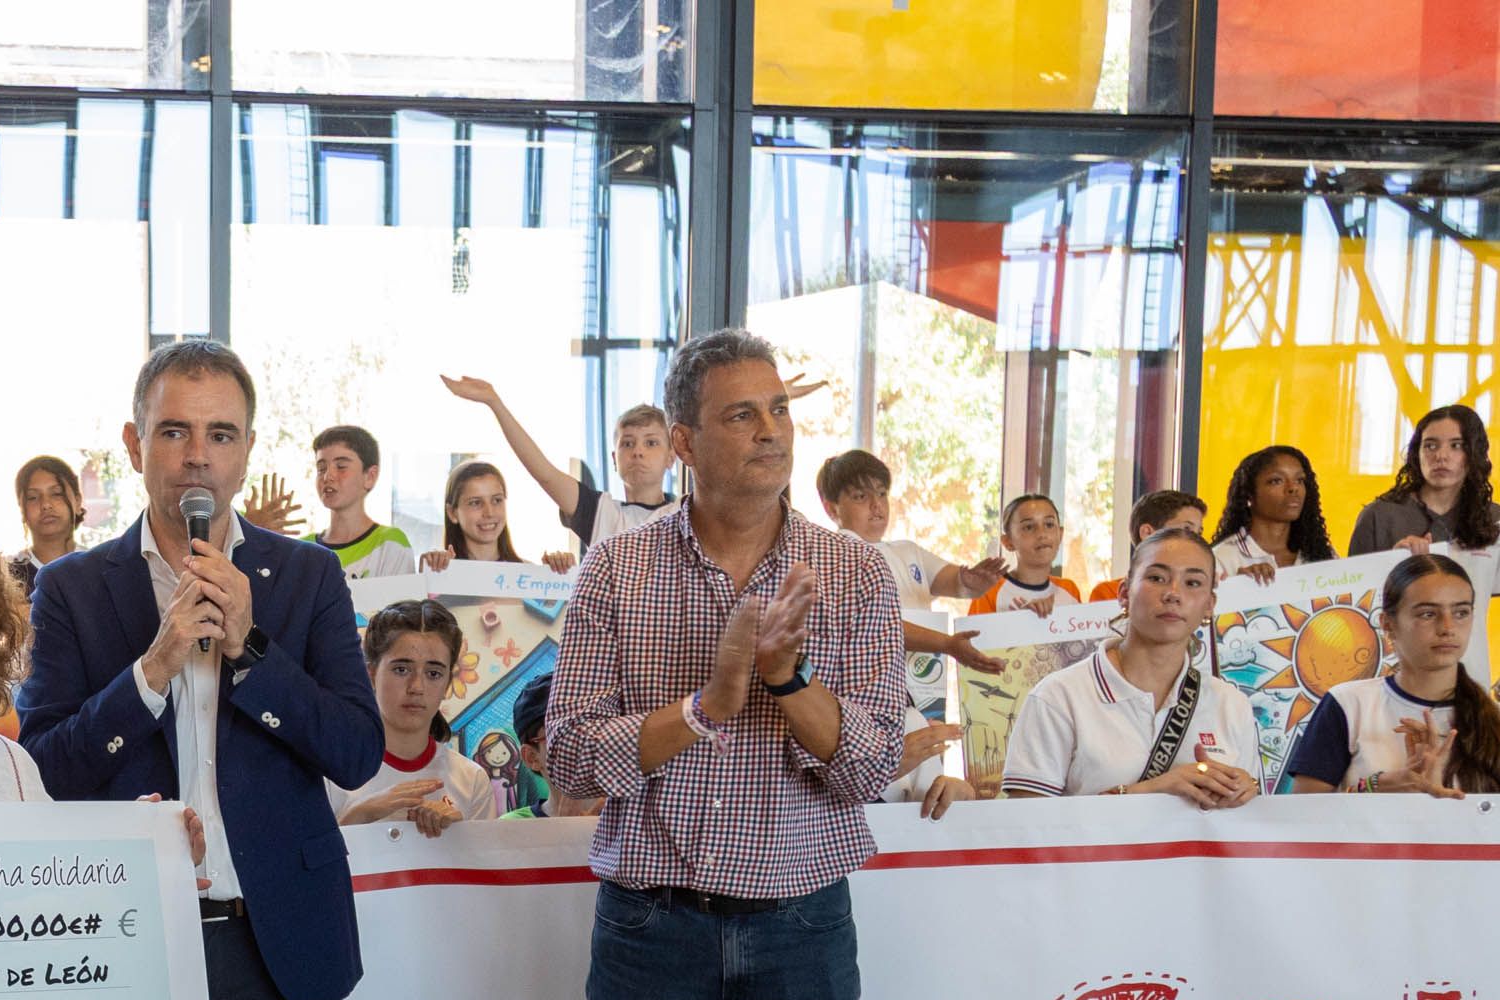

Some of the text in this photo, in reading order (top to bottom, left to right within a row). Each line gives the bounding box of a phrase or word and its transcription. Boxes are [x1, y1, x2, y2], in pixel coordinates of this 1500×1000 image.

[31, 855, 127, 887] solidaria
[117, 908, 138, 938] €
[6, 967, 35, 987] DE
[44, 955, 109, 986] LEÓN
